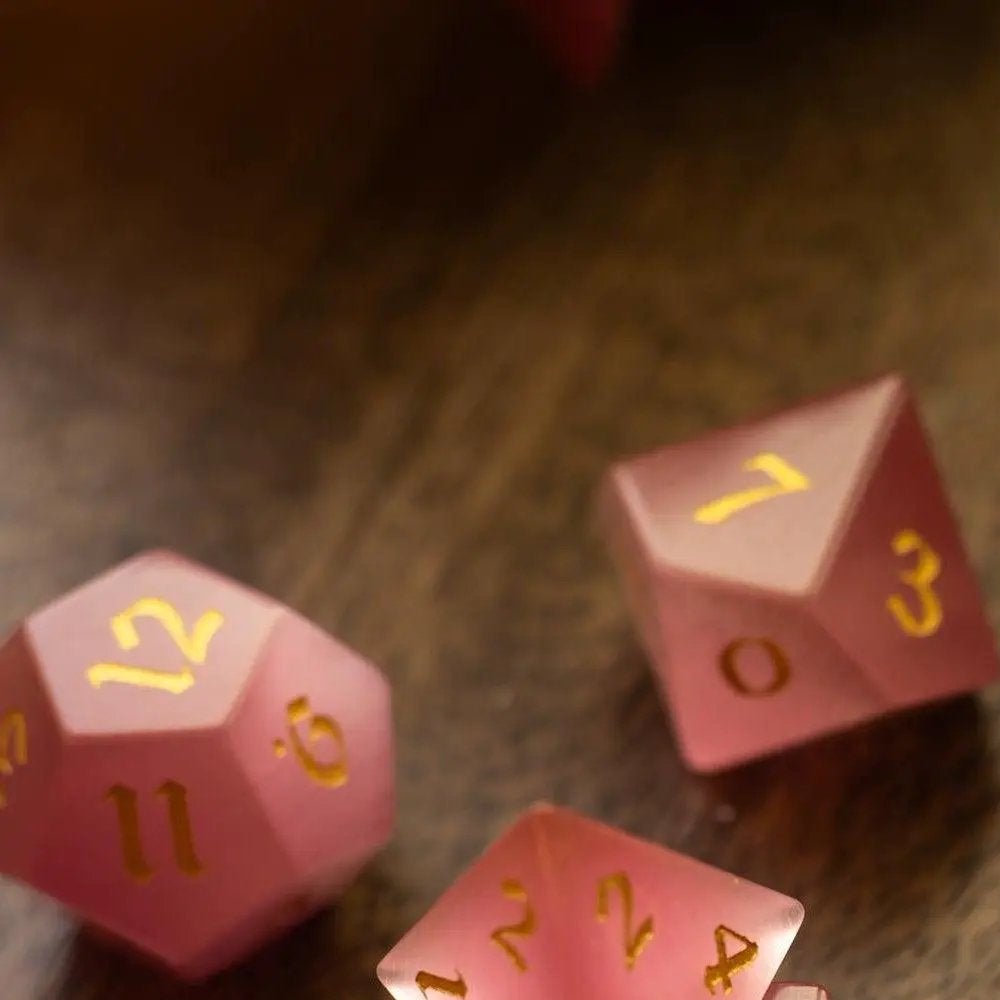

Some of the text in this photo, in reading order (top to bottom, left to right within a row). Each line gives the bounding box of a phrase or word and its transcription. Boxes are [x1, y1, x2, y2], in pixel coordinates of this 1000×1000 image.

[887, 529, 942, 637] 3
[86, 597, 225, 694] 12
[106, 779, 205, 884] 11
[490, 878, 536, 973] 2
[596, 871, 654, 972] 2
[704, 924, 759, 996] 4
[415, 969, 468, 1000] 1
